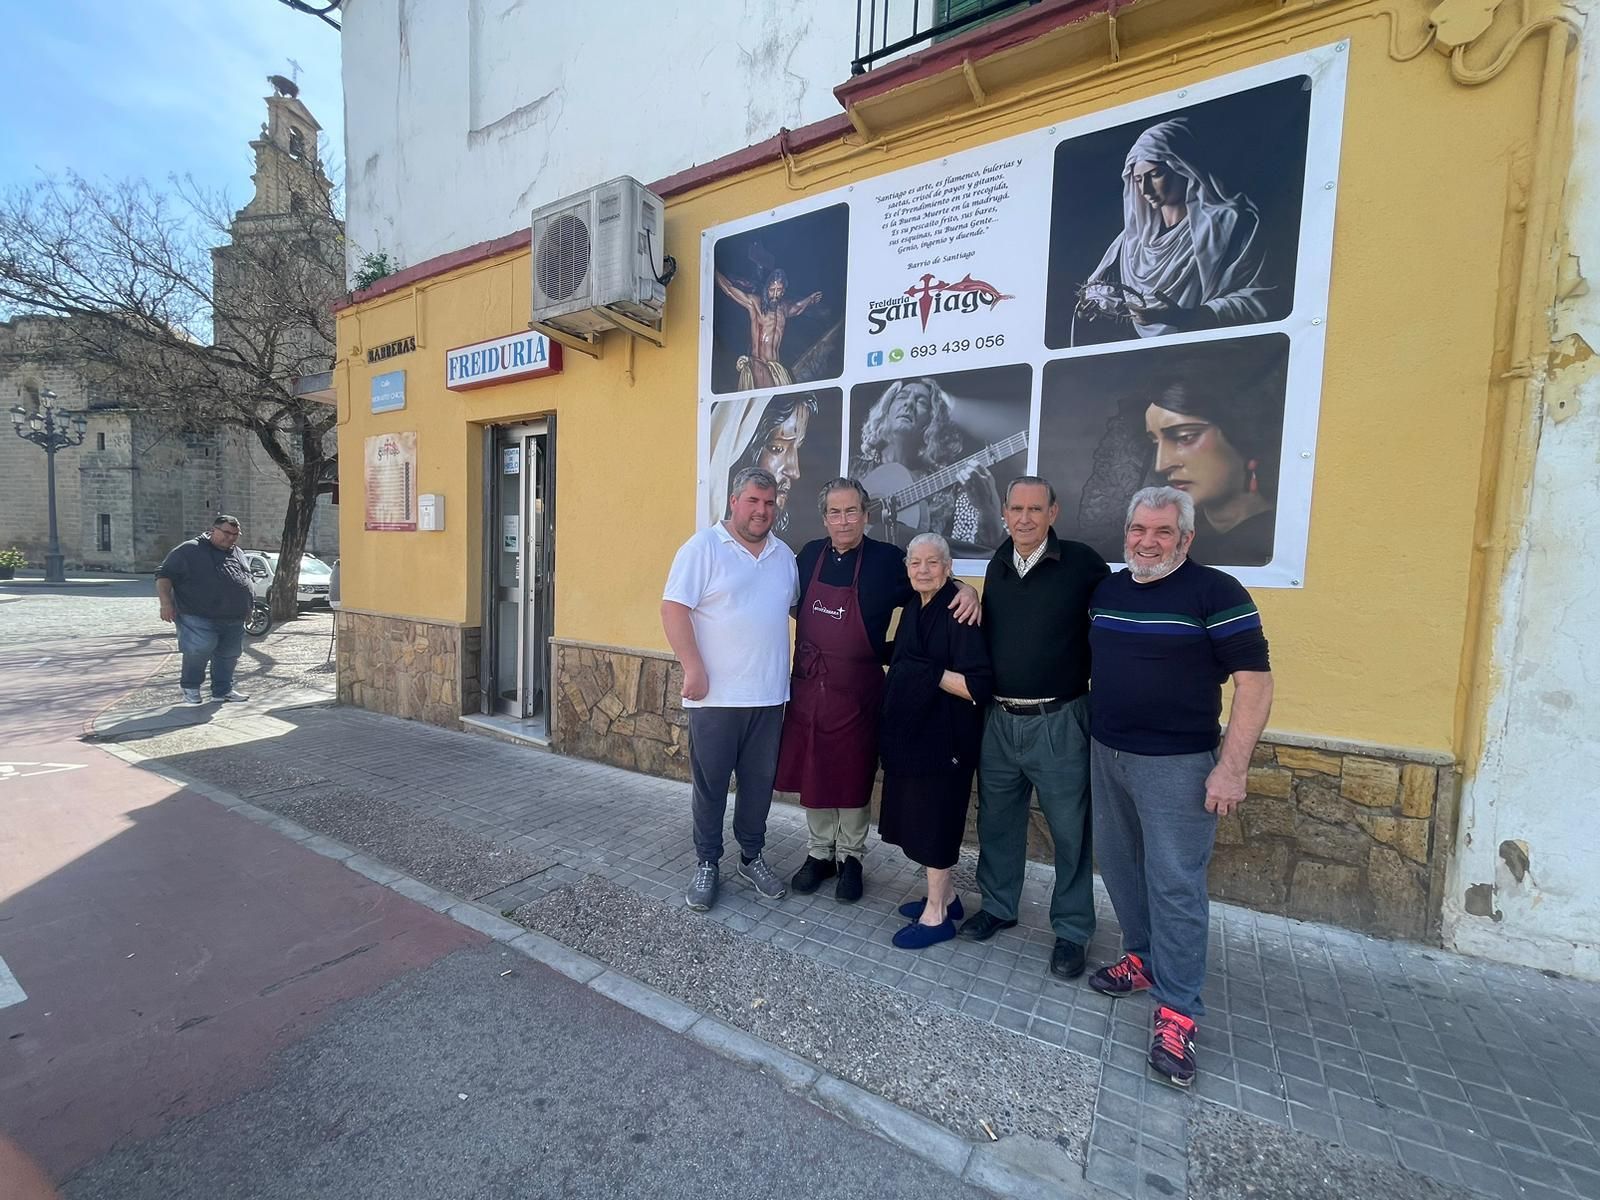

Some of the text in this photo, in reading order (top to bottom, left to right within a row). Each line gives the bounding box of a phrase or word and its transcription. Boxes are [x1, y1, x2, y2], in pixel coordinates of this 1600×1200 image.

[917, 183, 934, 193] arte,
[943, 171, 980, 186] flamenco,
[1016, 158, 1023, 168] y
[912, 190, 934, 203] crisol
[933, 188, 942, 198] de
[942, 184, 965, 197] payos
[967, 182, 973, 191] y
[884, 212, 892, 220] Es
[893, 208, 901, 217] el
[901, 198, 950, 216] Prendimiento
[951, 195, 961, 203] en
[962, 192, 971, 200] su
[890, 218, 897, 228] la
[899, 215, 921, 225] Buena
[922, 207, 950, 220] Muerte
[962, 201, 970, 209] la
[888, 238, 899, 247] sus
[934, 228, 943, 236] su
[944, 222, 968, 234] Buena
[891, 229, 900, 237] Es
[900, 226, 909, 234] su
[961, 211, 973, 220] sus
[921, 237, 948, 249] ingenio
[949, 235, 955, 244] y
[907, 250, 976, 270] Barrio de Santiago
[448, 335, 547, 381] FREIDURIA
[911, 334, 1005, 358] 693 439 056
